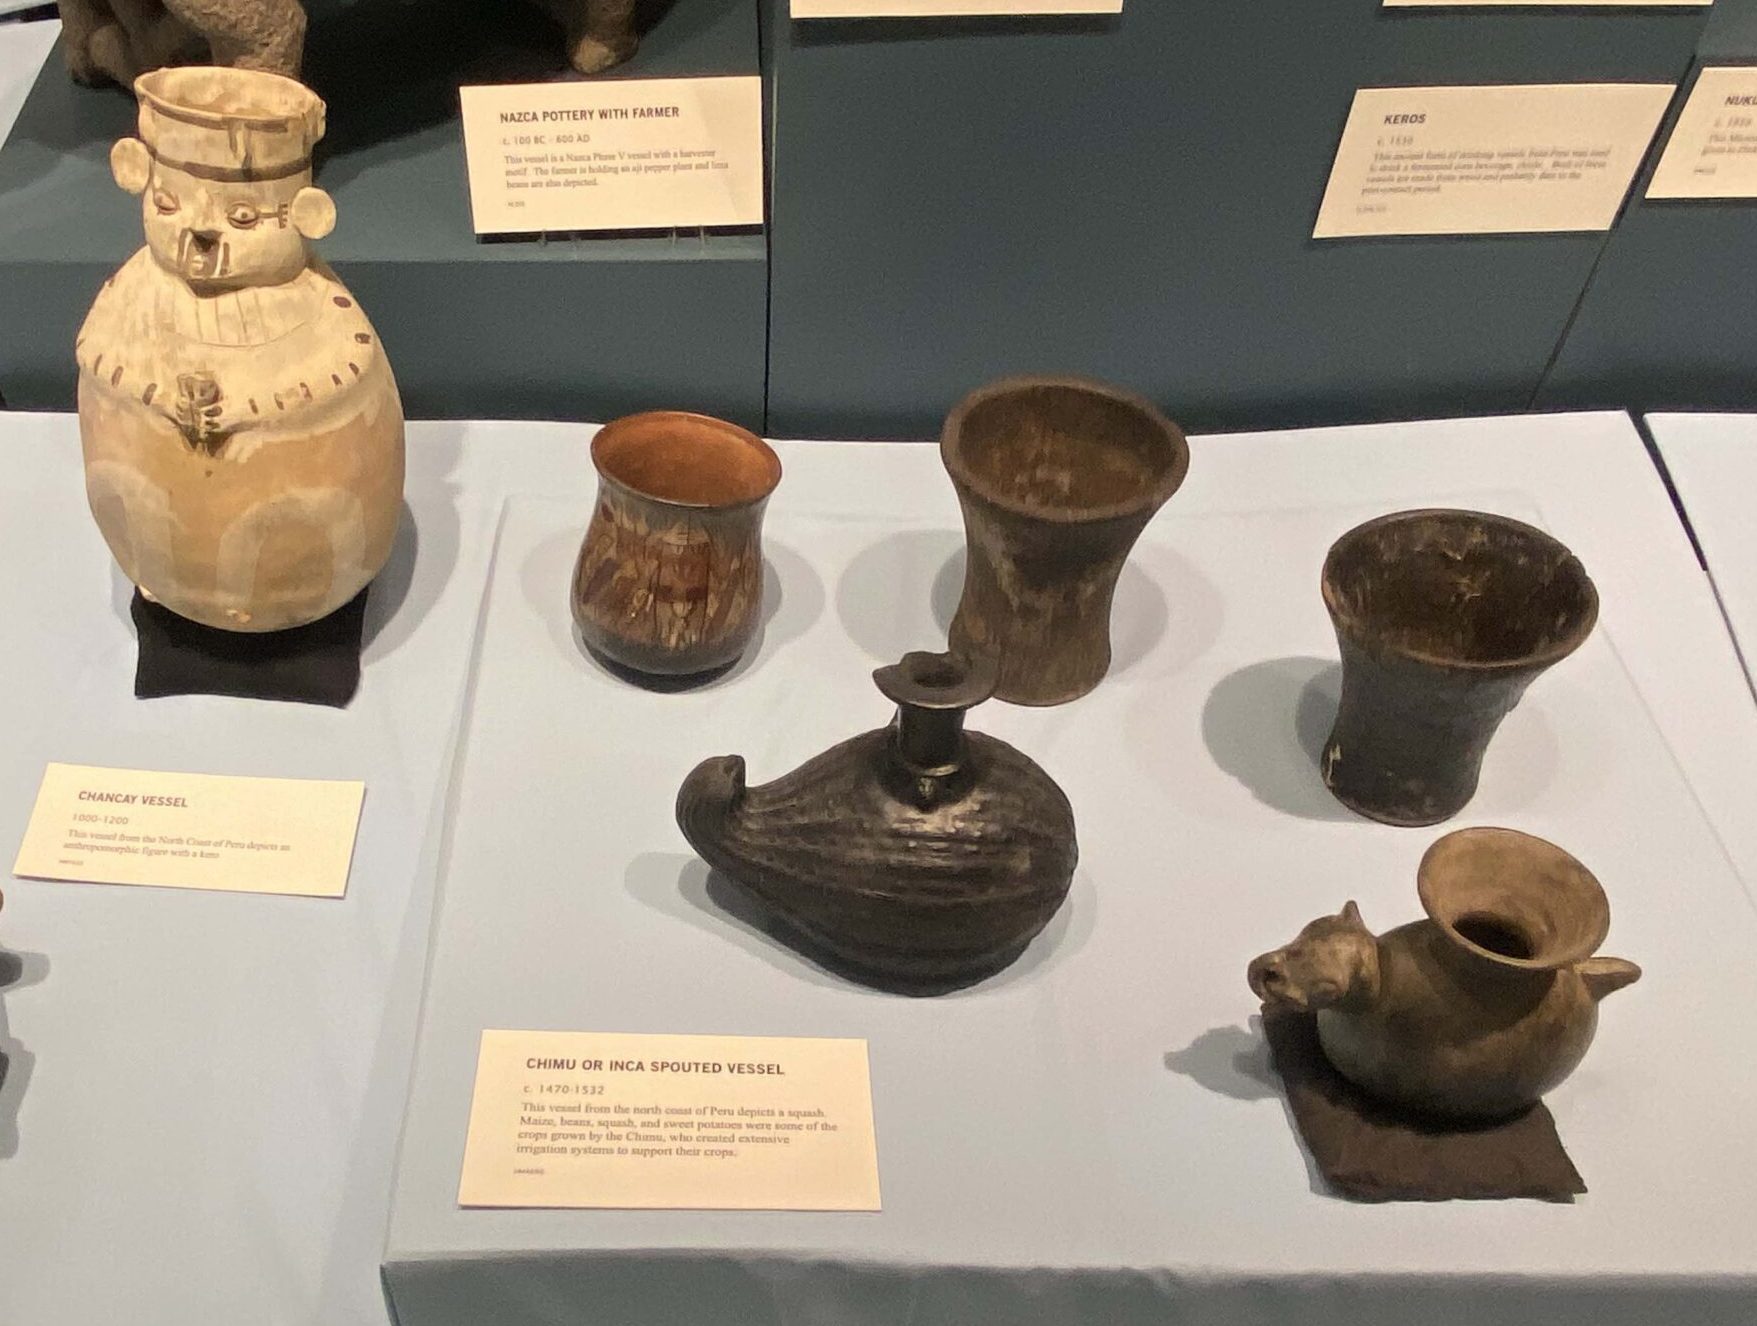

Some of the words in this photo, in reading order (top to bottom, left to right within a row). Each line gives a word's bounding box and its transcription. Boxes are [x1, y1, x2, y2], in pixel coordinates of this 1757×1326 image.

[500, 112, 539, 123] NAZCA
[542, 110, 594, 121] POTTERY
[598, 108, 629, 120] WITH
[633, 107, 679, 118] FARMER
[1384, 114, 1426, 124] KEROS
[515, 136, 531, 145] 100
[534, 136, 545, 144] BC
[556, 135, 574, 143] 600
[577, 134, 590, 143] AD
[504, 155, 522, 164] This
[524, 153, 548, 163] vessel
[551, 153, 557, 162] is
[566, 153, 591, 162] Nazca
[627, 150, 651, 159] vessel
[653, 150, 671, 158] with
[588, 165, 619, 175] holding
[695, 161, 709, 170] and
[546, 179, 561, 187] also
[78, 791, 138, 805] CHANCAY
[142, 795, 189, 808] VESSEL
[73, 814, 129, 825] 1000-1200
[68, 829, 87, 838] This
[90, 832, 117, 840] vessel
[119, 834, 140, 842] from
[157, 836, 184, 845] North
[186, 837, 211, 847] Coast
[213, 840, 225, 848] of
[225, 840, 245, 849] Peru
[247, 841, 278, 851] depicts
[63, 843, 140, 855] anthropomorphic
[142, 847, 169, 856] figure
[171, 847, 191, 858] with
[526, 1058, 577, 1071] CHIMU
[581, 1059, 603, 1071] OR
[609, 1060, 645, 1072] INCA
[650, 1061, 722, 1074] SPOUTED
[728, 1062, 786, 1076] VESSEL
[539, 1085, 605, 1095] 1470-1532
[521, 1103, 546, 1112] This
[549, 1103, 581, 1113] vessel
[584, 1104, 611, 1113] from
[614, 1105, 629, 1114] the
[633, 1105, 662, 1114] north
[665, 1107, 692, 1115] coast
[695, 1106, 708, 1115] of
[710, 1106, 735, 1116] Peru
[737, 1107, 775, 1118] depicts
[560, 1117, 595, 1127] beans,
[597, 1118, 637, 1129] squash,
[640, 1119, 661, 1128] and
[664, 1120, 694, 1129] sweet
[697, 1121, 742, 1131] potatoes
[775, 1123, 804, 1131] some
[806, 1121, 820, 1131] of
[821, 1122, 838, 1131] the
[518, 1131, 547, 1141] crops
[551, 1133, 586, 1142] grown
[589, 1131, 603, 1143] by
[606, 1132, 623, 1141] the
[626, 1132, 666, 1142] Chimu,
[670, 1133, 692, 1142] who
[696, 1134, 735, 1143] created
[738, 1134, 790, 1144] extensive
[516, 1144, 568, 1155] irrigation
[571, 1146, 614, 1156] systems
[617, 1146, 628, 1155] to
[631, 1148, 672, 1158] support
[676, 1147, 700, 1156] their
[703, 1149, 737, 1159] crops.
